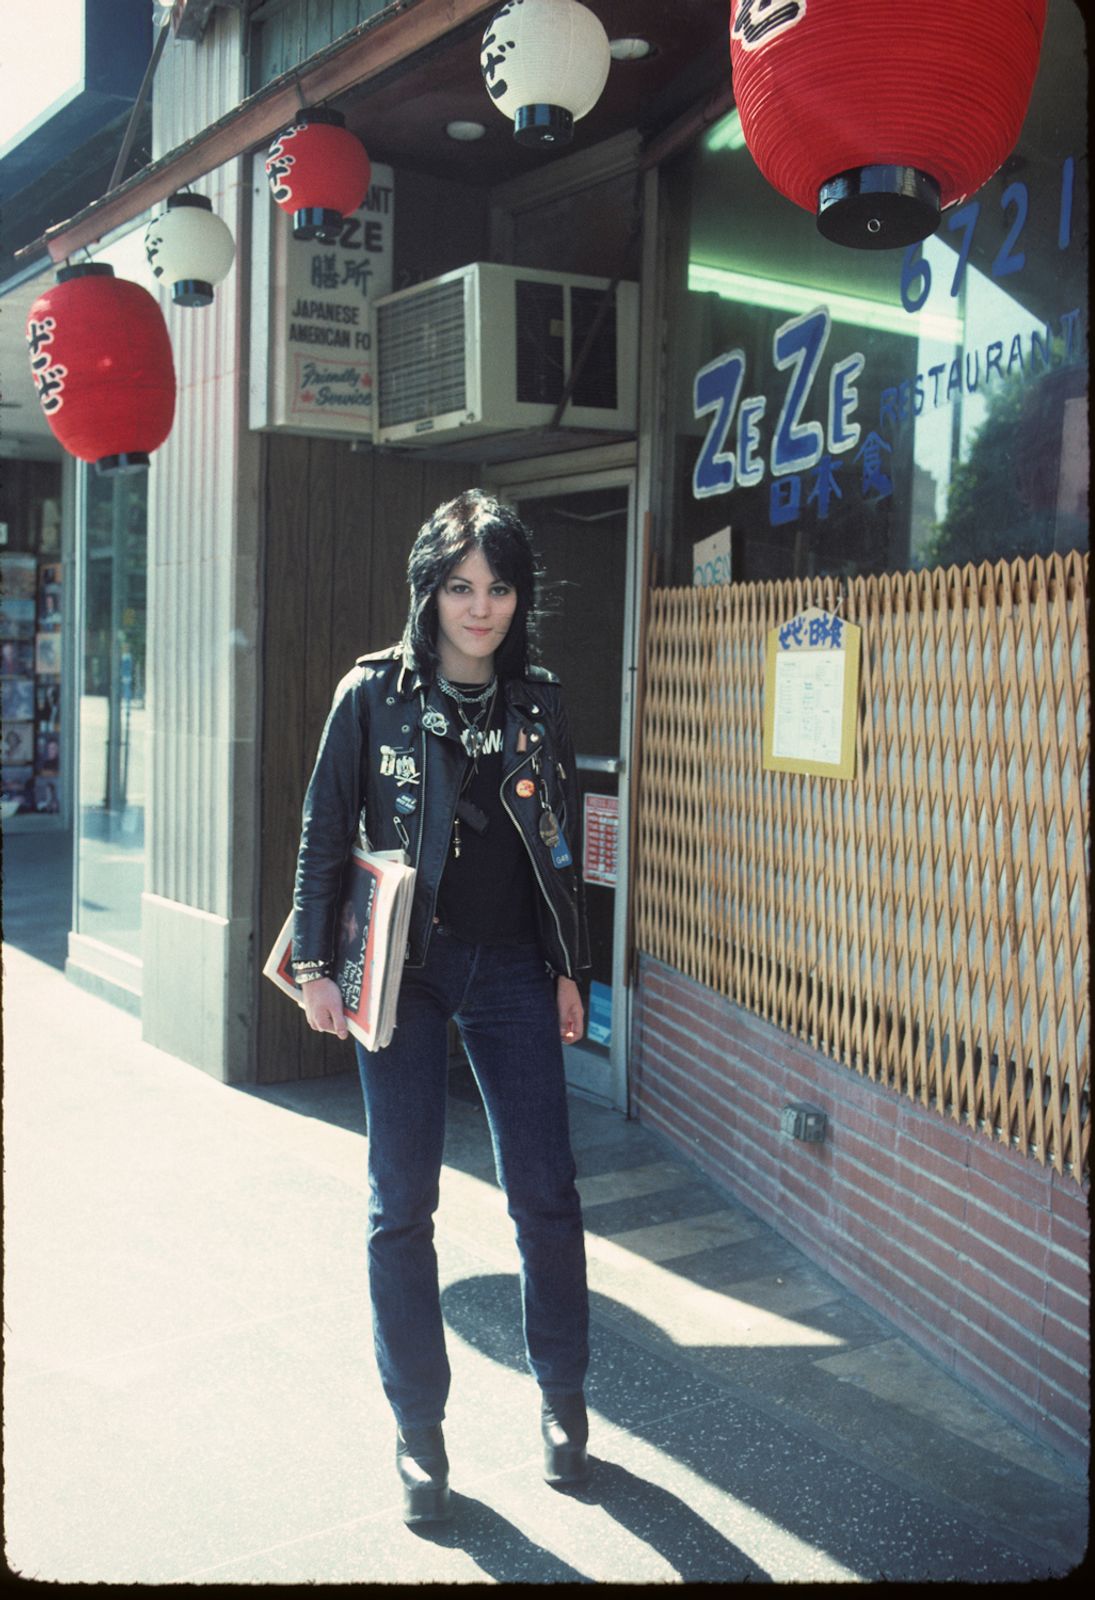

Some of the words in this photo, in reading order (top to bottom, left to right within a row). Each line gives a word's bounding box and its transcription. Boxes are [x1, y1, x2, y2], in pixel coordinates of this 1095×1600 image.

[900, 156, 1075, 314] 6721
[288, 323, 351, 349] AMERICAN
[292, 299, 361, 326] JAPANESE
[301, 362, 362, 389] Friendly
[315, 385, 373, 406] Service
[878, 307, 1081, 432] RESTAURANT
[768, 431, 893, 527] 日本食
[350, 924, 369, 1010] CARMEN
